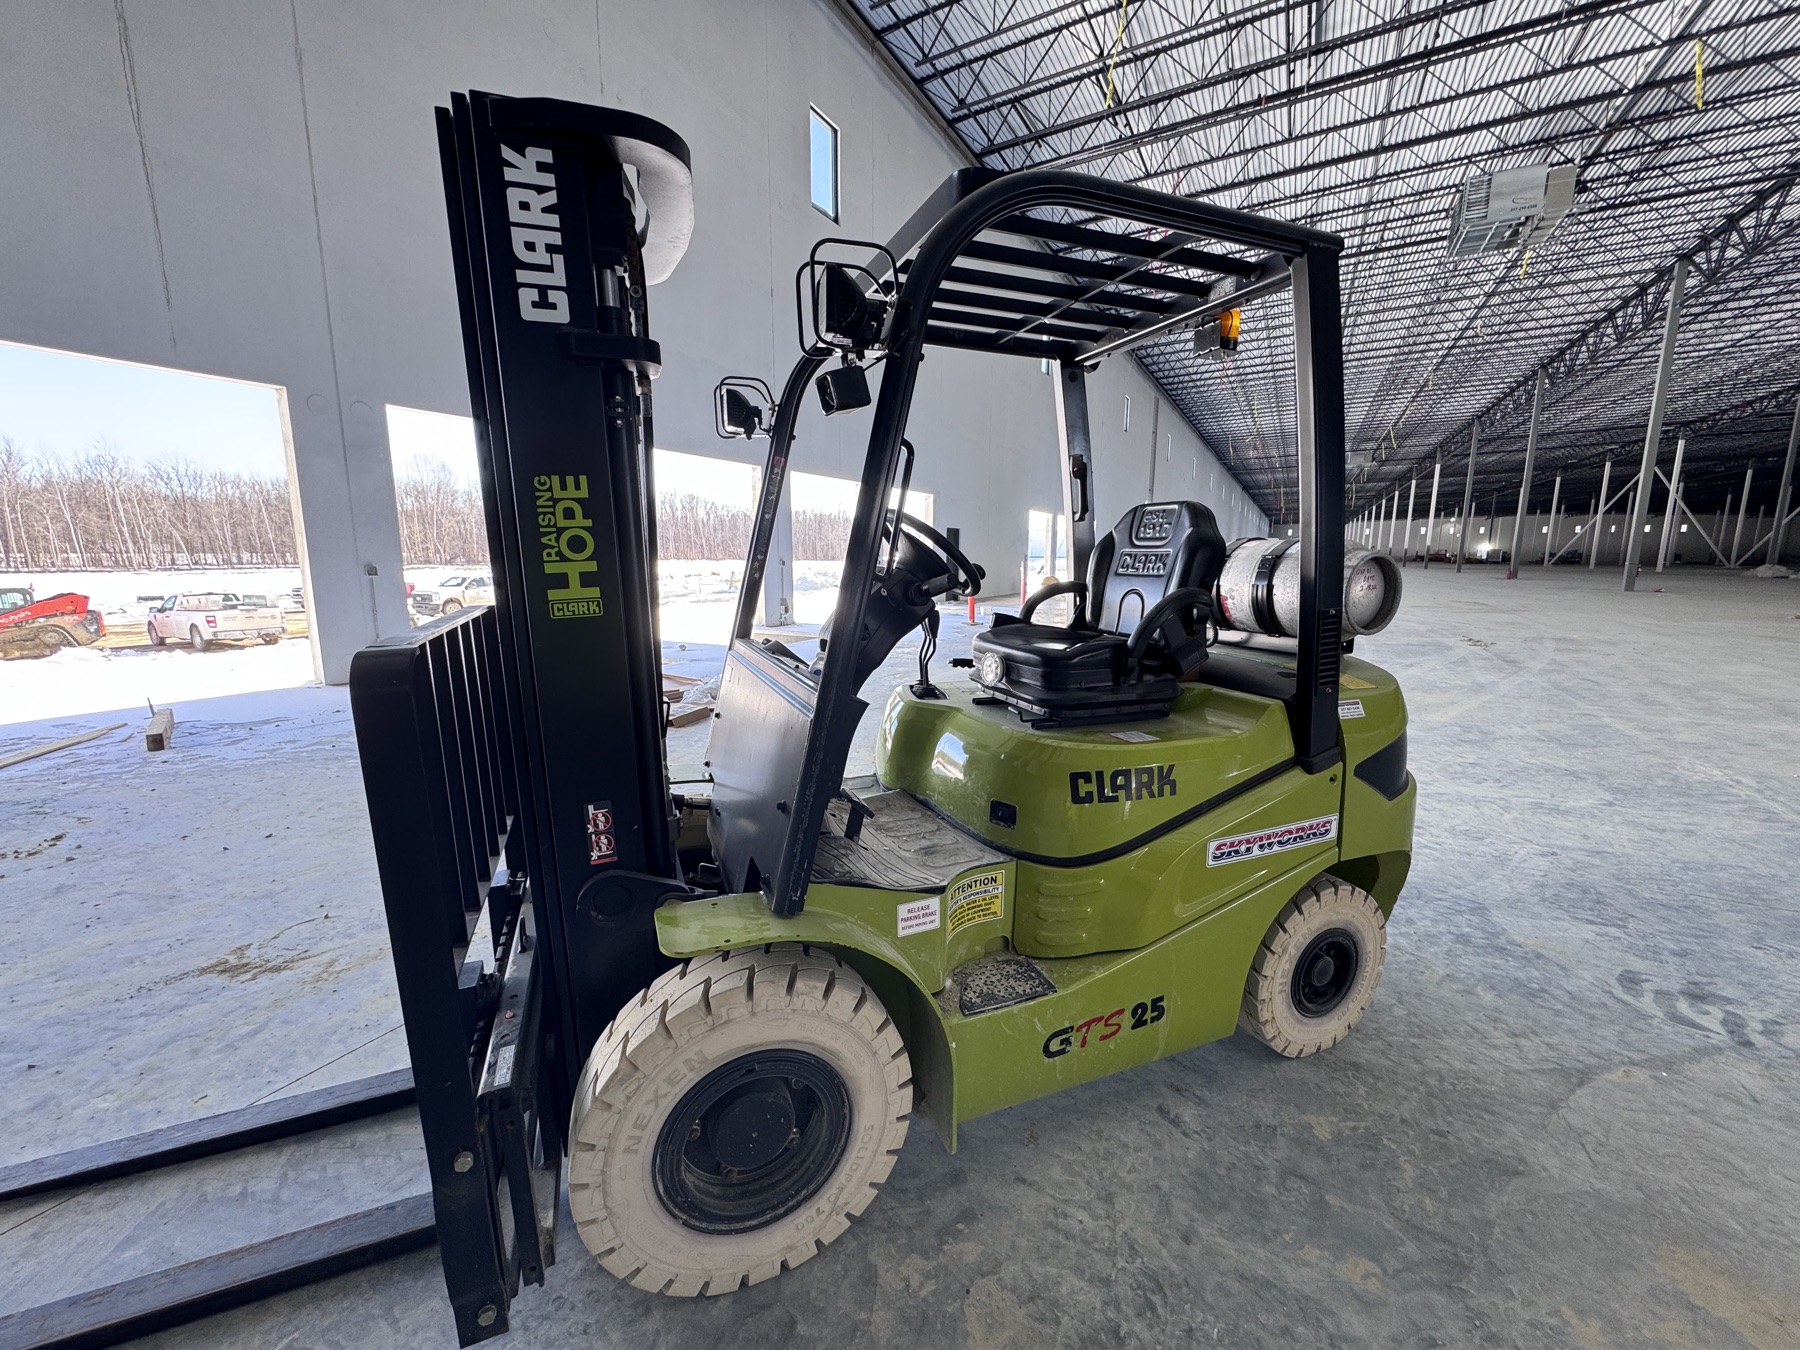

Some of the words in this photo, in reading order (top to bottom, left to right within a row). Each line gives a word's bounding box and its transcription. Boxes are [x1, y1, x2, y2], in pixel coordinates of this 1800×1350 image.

[500, 143, 571, 324] CLARK
[533, 475, 560, 561] RAISING
[1140, 522, 1172, 538] 1917
[544, 474, 601, 600] HOPE
[1119, 553, 1171, 575] CLARK
[553, 601, 600, 616] CLARK
[1069, 764, 1177, 805] CLARK
[1211, 818, 1333, 862] SKYWORKS
[950, 875, 997, 900] ATTENTION
[900, 913, 921, 923] PARKING
[922, 910, 937, 918] BRAKE
[907, 904, 931, 914] RELEASE
[1042, 1008, 1125, 1059] GTS
[1131, 995, 1165, 1031] 25
[622, 1048, 709, 1154] NEXEN
[795, 1206, 826, 1231] 700
